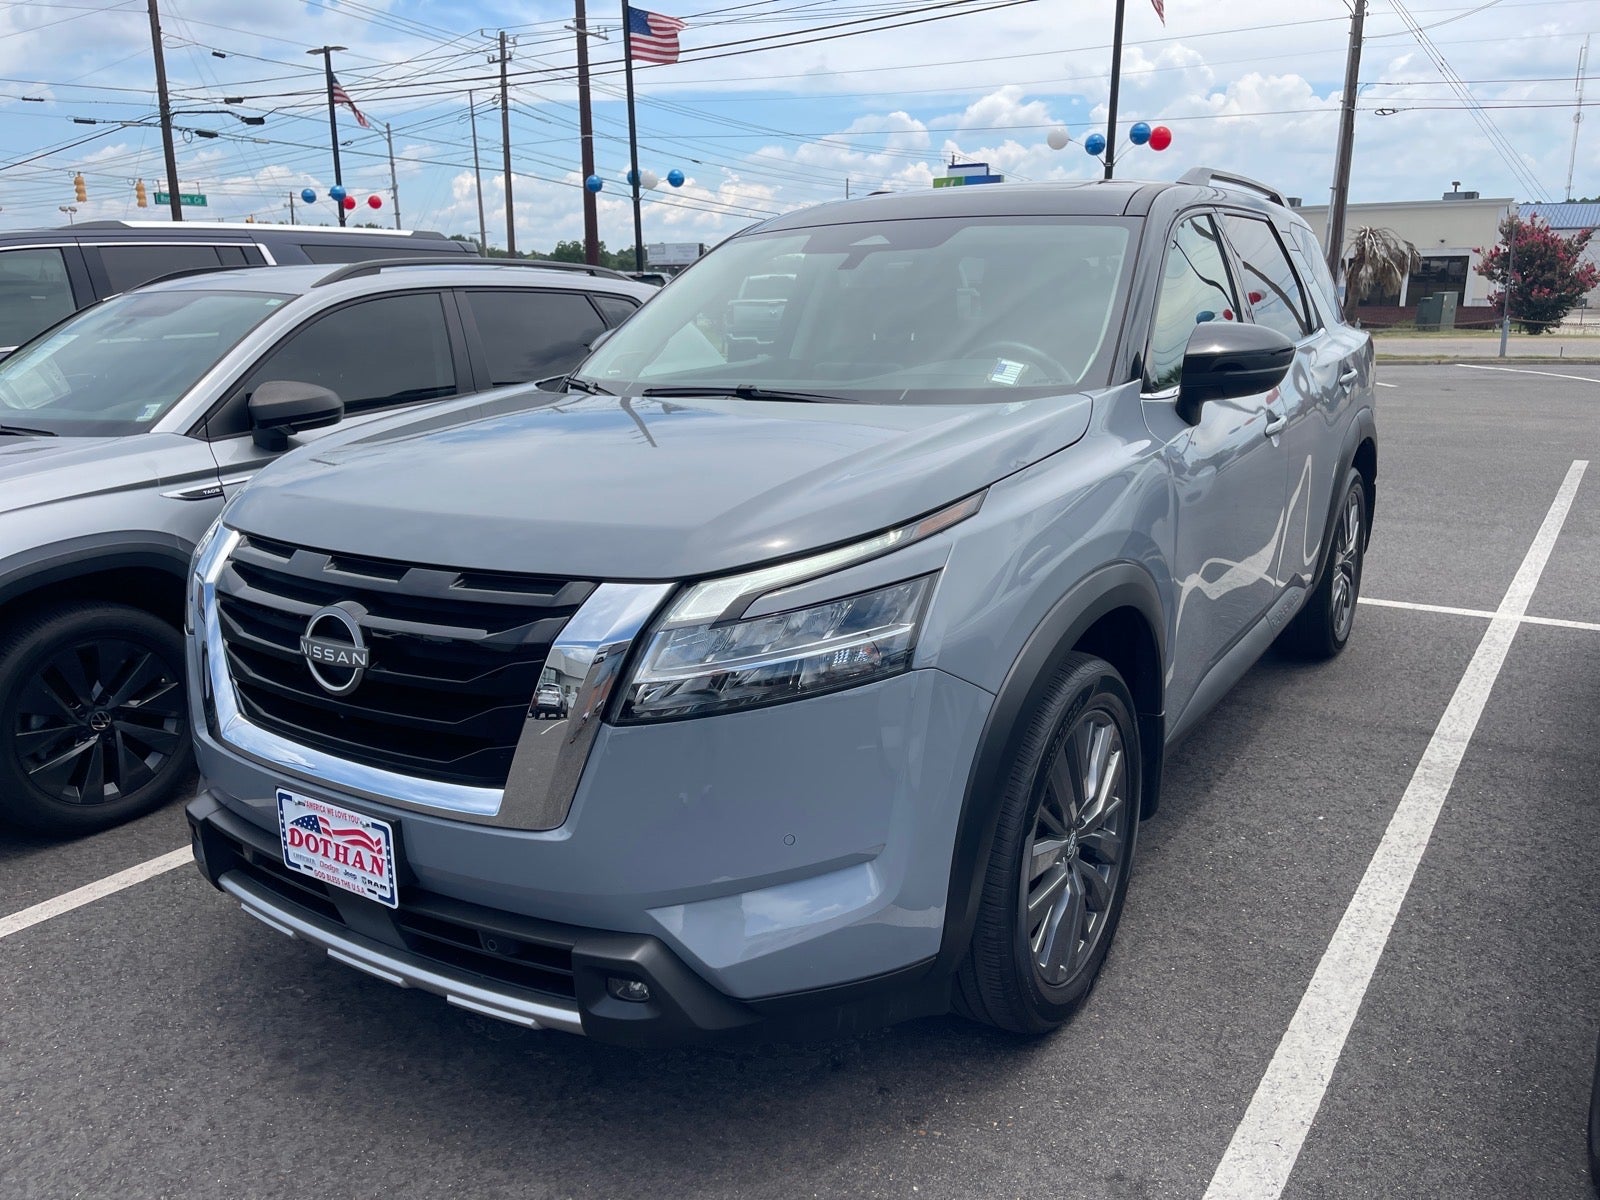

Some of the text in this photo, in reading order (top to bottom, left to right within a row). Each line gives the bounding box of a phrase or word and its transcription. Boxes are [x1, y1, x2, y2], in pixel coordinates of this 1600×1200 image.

[301, 640, 366, 666] NISSAN
[327, 806, 335, 817] WE
[335, 808, 349, 820] LOVE
[288, 827, 386, 878] DOTHAN
[313, 869, 326, 879] GOD
[326, 873, 340, 885] BLESS
[341, 879, 351, 889] THE
[320, 860, 340, 874] Dodge
[343, 869, 358, 880] Jeep
[367, 879, 387, 891] RAM
